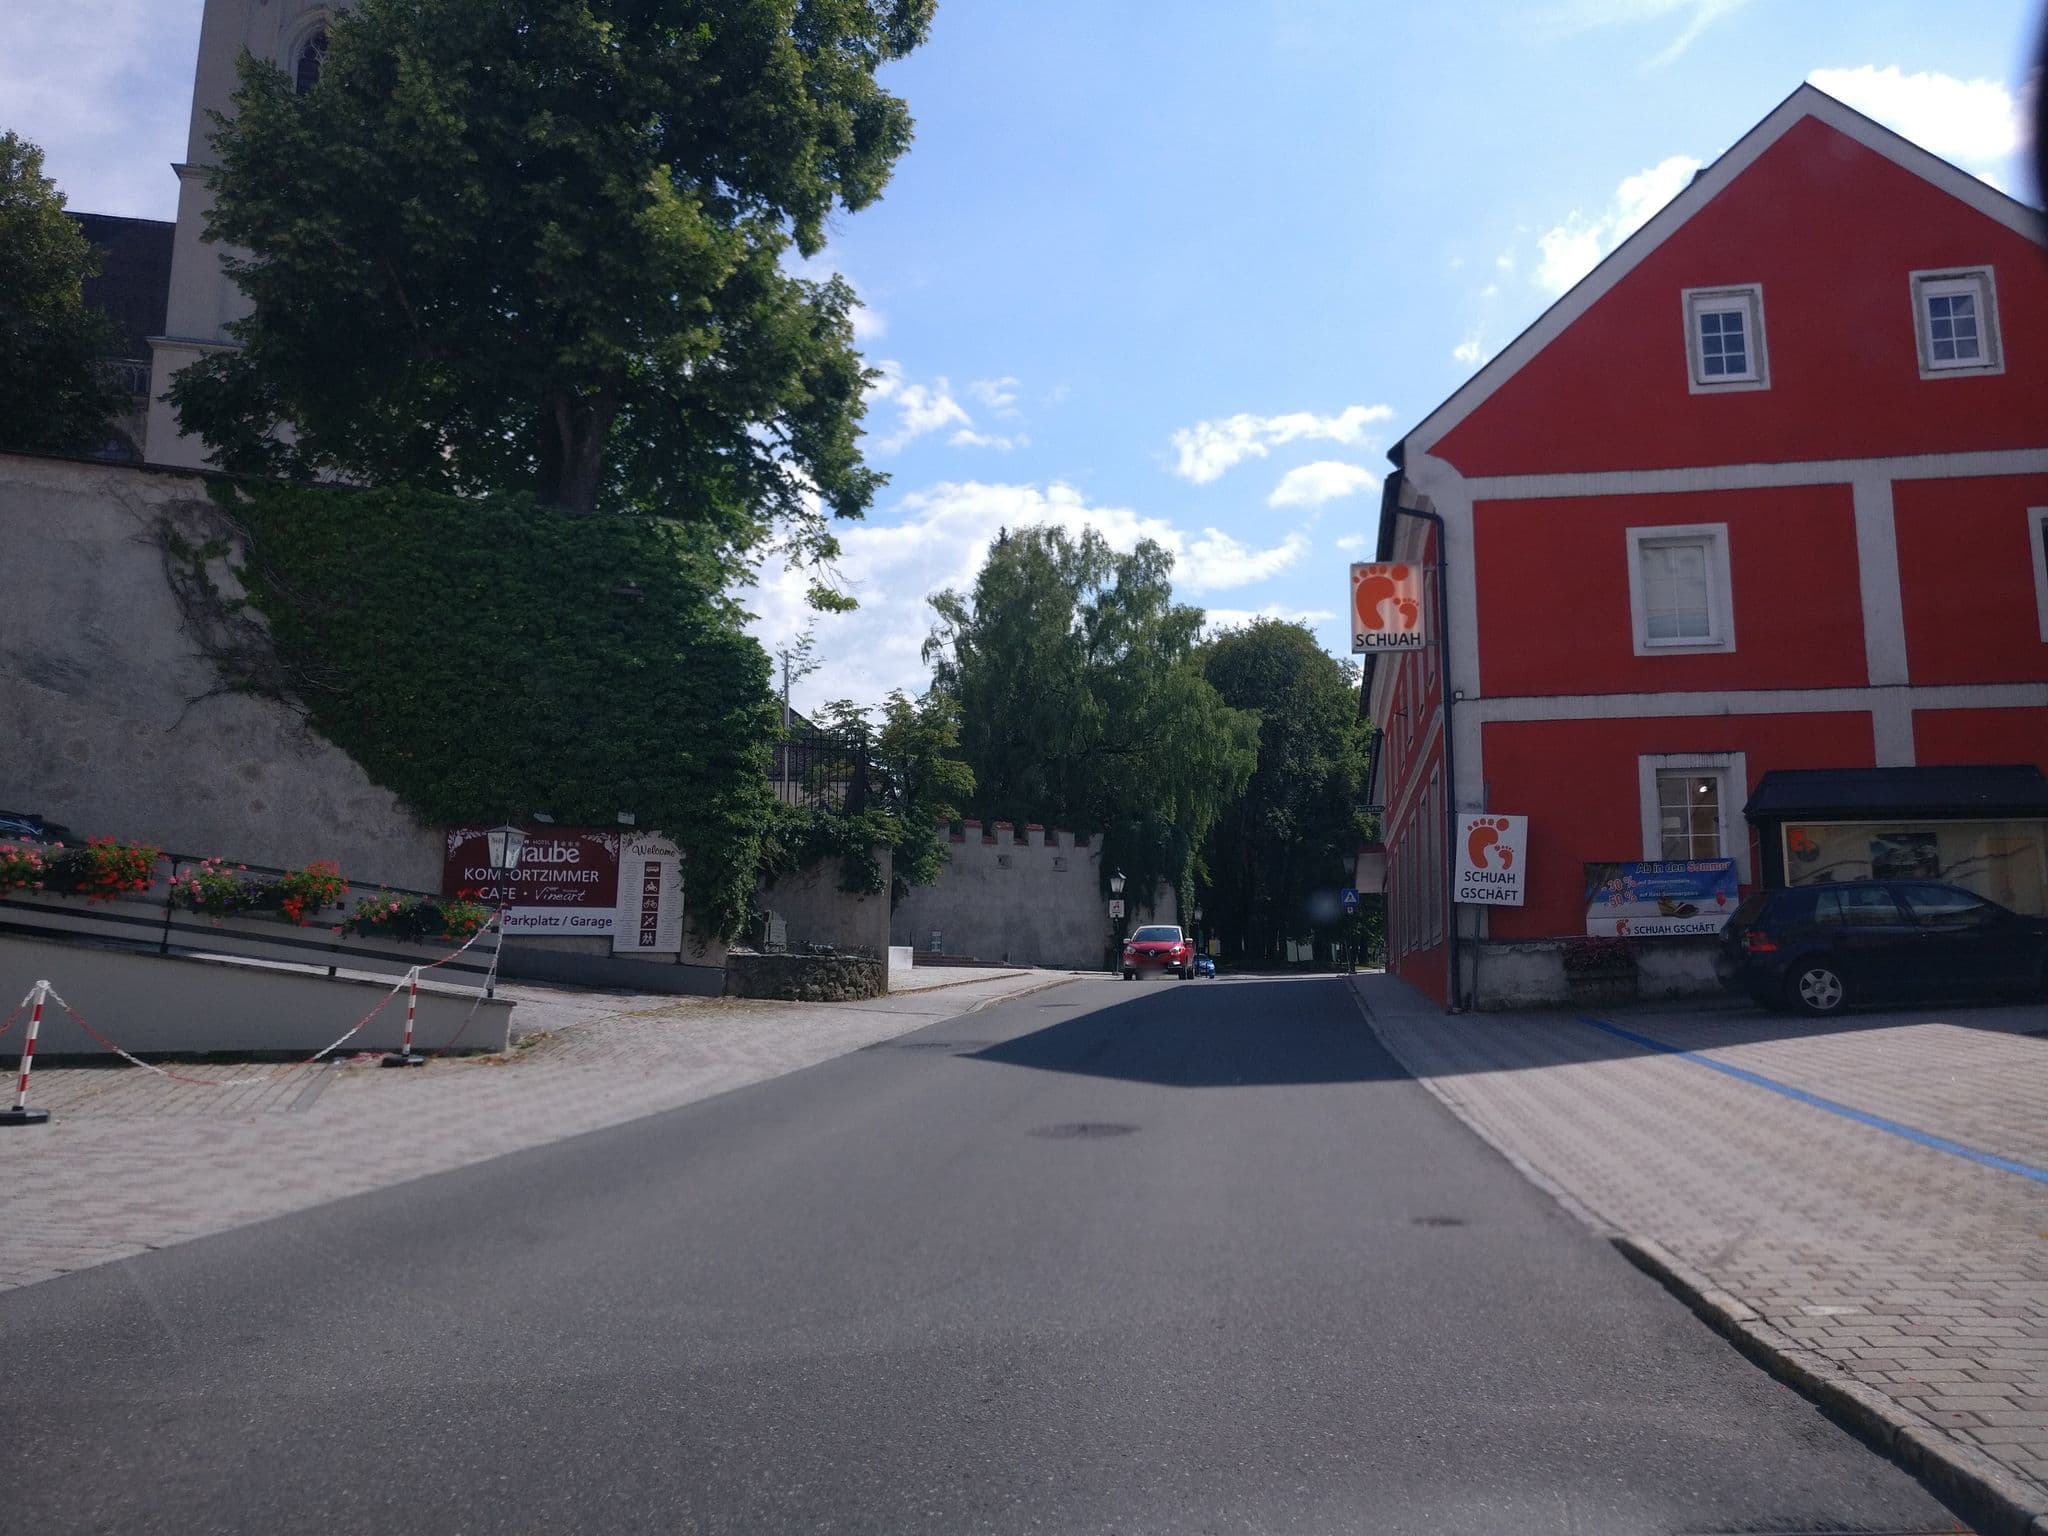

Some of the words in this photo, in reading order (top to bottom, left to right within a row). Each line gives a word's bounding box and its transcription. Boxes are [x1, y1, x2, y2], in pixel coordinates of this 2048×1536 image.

[1356, 633, 1421, 647] SCHUAH
[632, 845, 676, 858] Welcome
[1653, 862, 1664, 873] in
[1665, 863, 1686, 873] den
[464, 868, 600, 883] KOMORTZIMMER
[1464, 871, 1516, 884] SCHUAH
[1461, 886, 1518, 901] GSCHÄFT
[503, 914, 560, 928] Parkplatz
[570, 916, 612, 929] Garage
[1633, 924, 1671, 935] SCHUAH
[1673, 922, 1715, 934] GSCHÄFT
